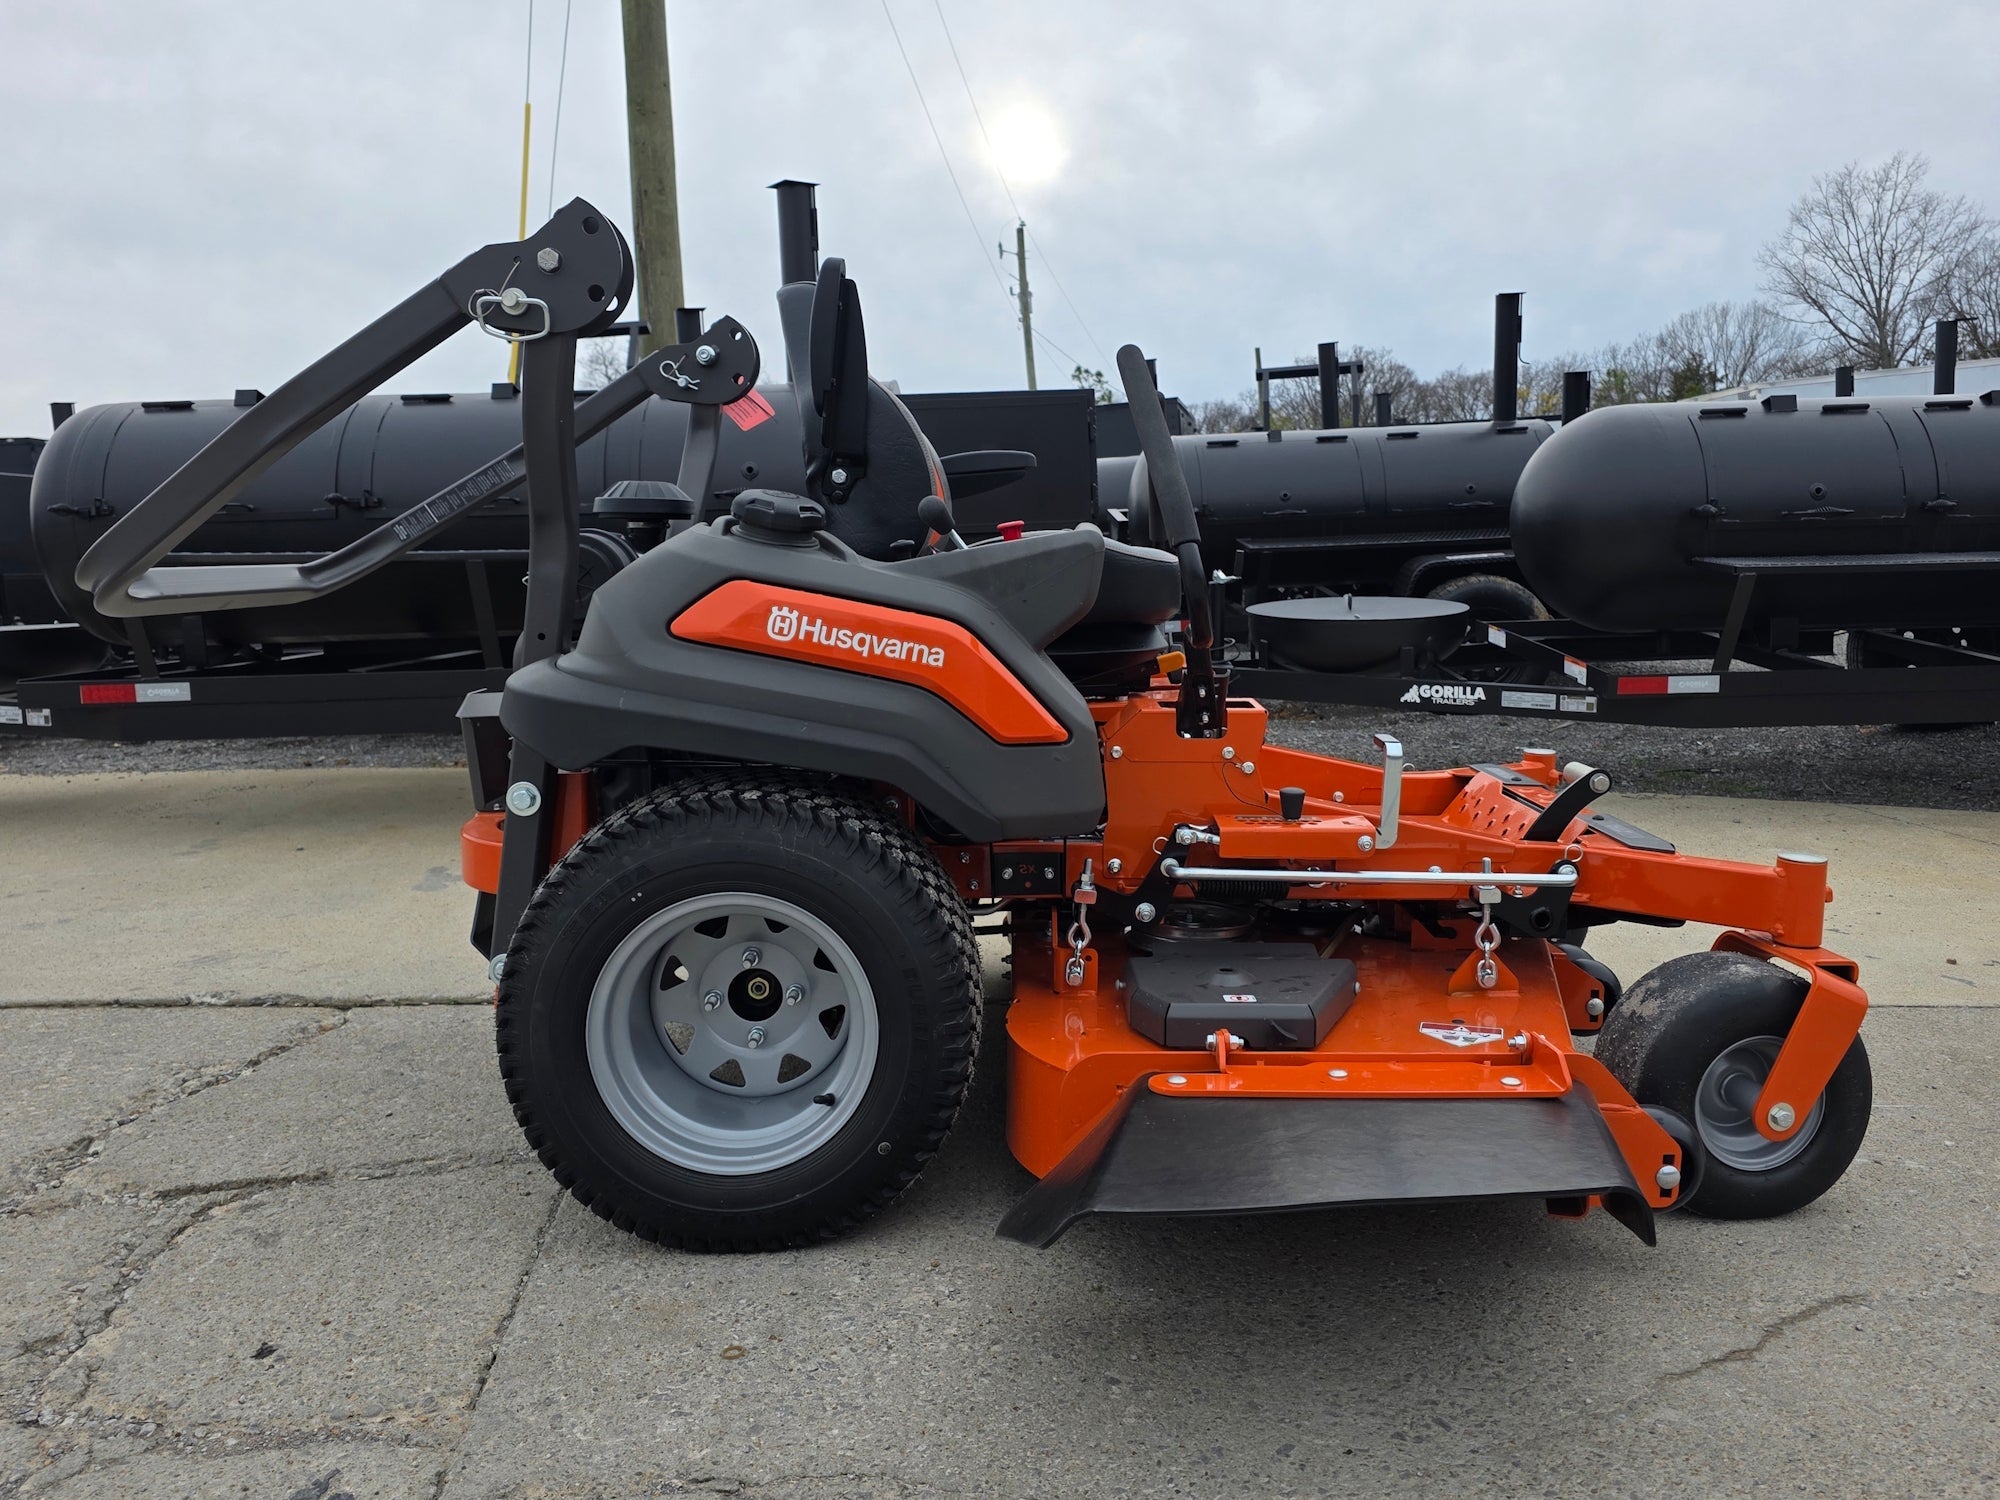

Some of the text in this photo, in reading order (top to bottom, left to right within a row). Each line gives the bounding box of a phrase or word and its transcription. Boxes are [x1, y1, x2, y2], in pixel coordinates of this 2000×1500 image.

[798, 615, 945, 667] Husqvarna
[1419, 684, 1487, 702] GORILLA
[1431, 696, 1476, 706] TRAILERS
